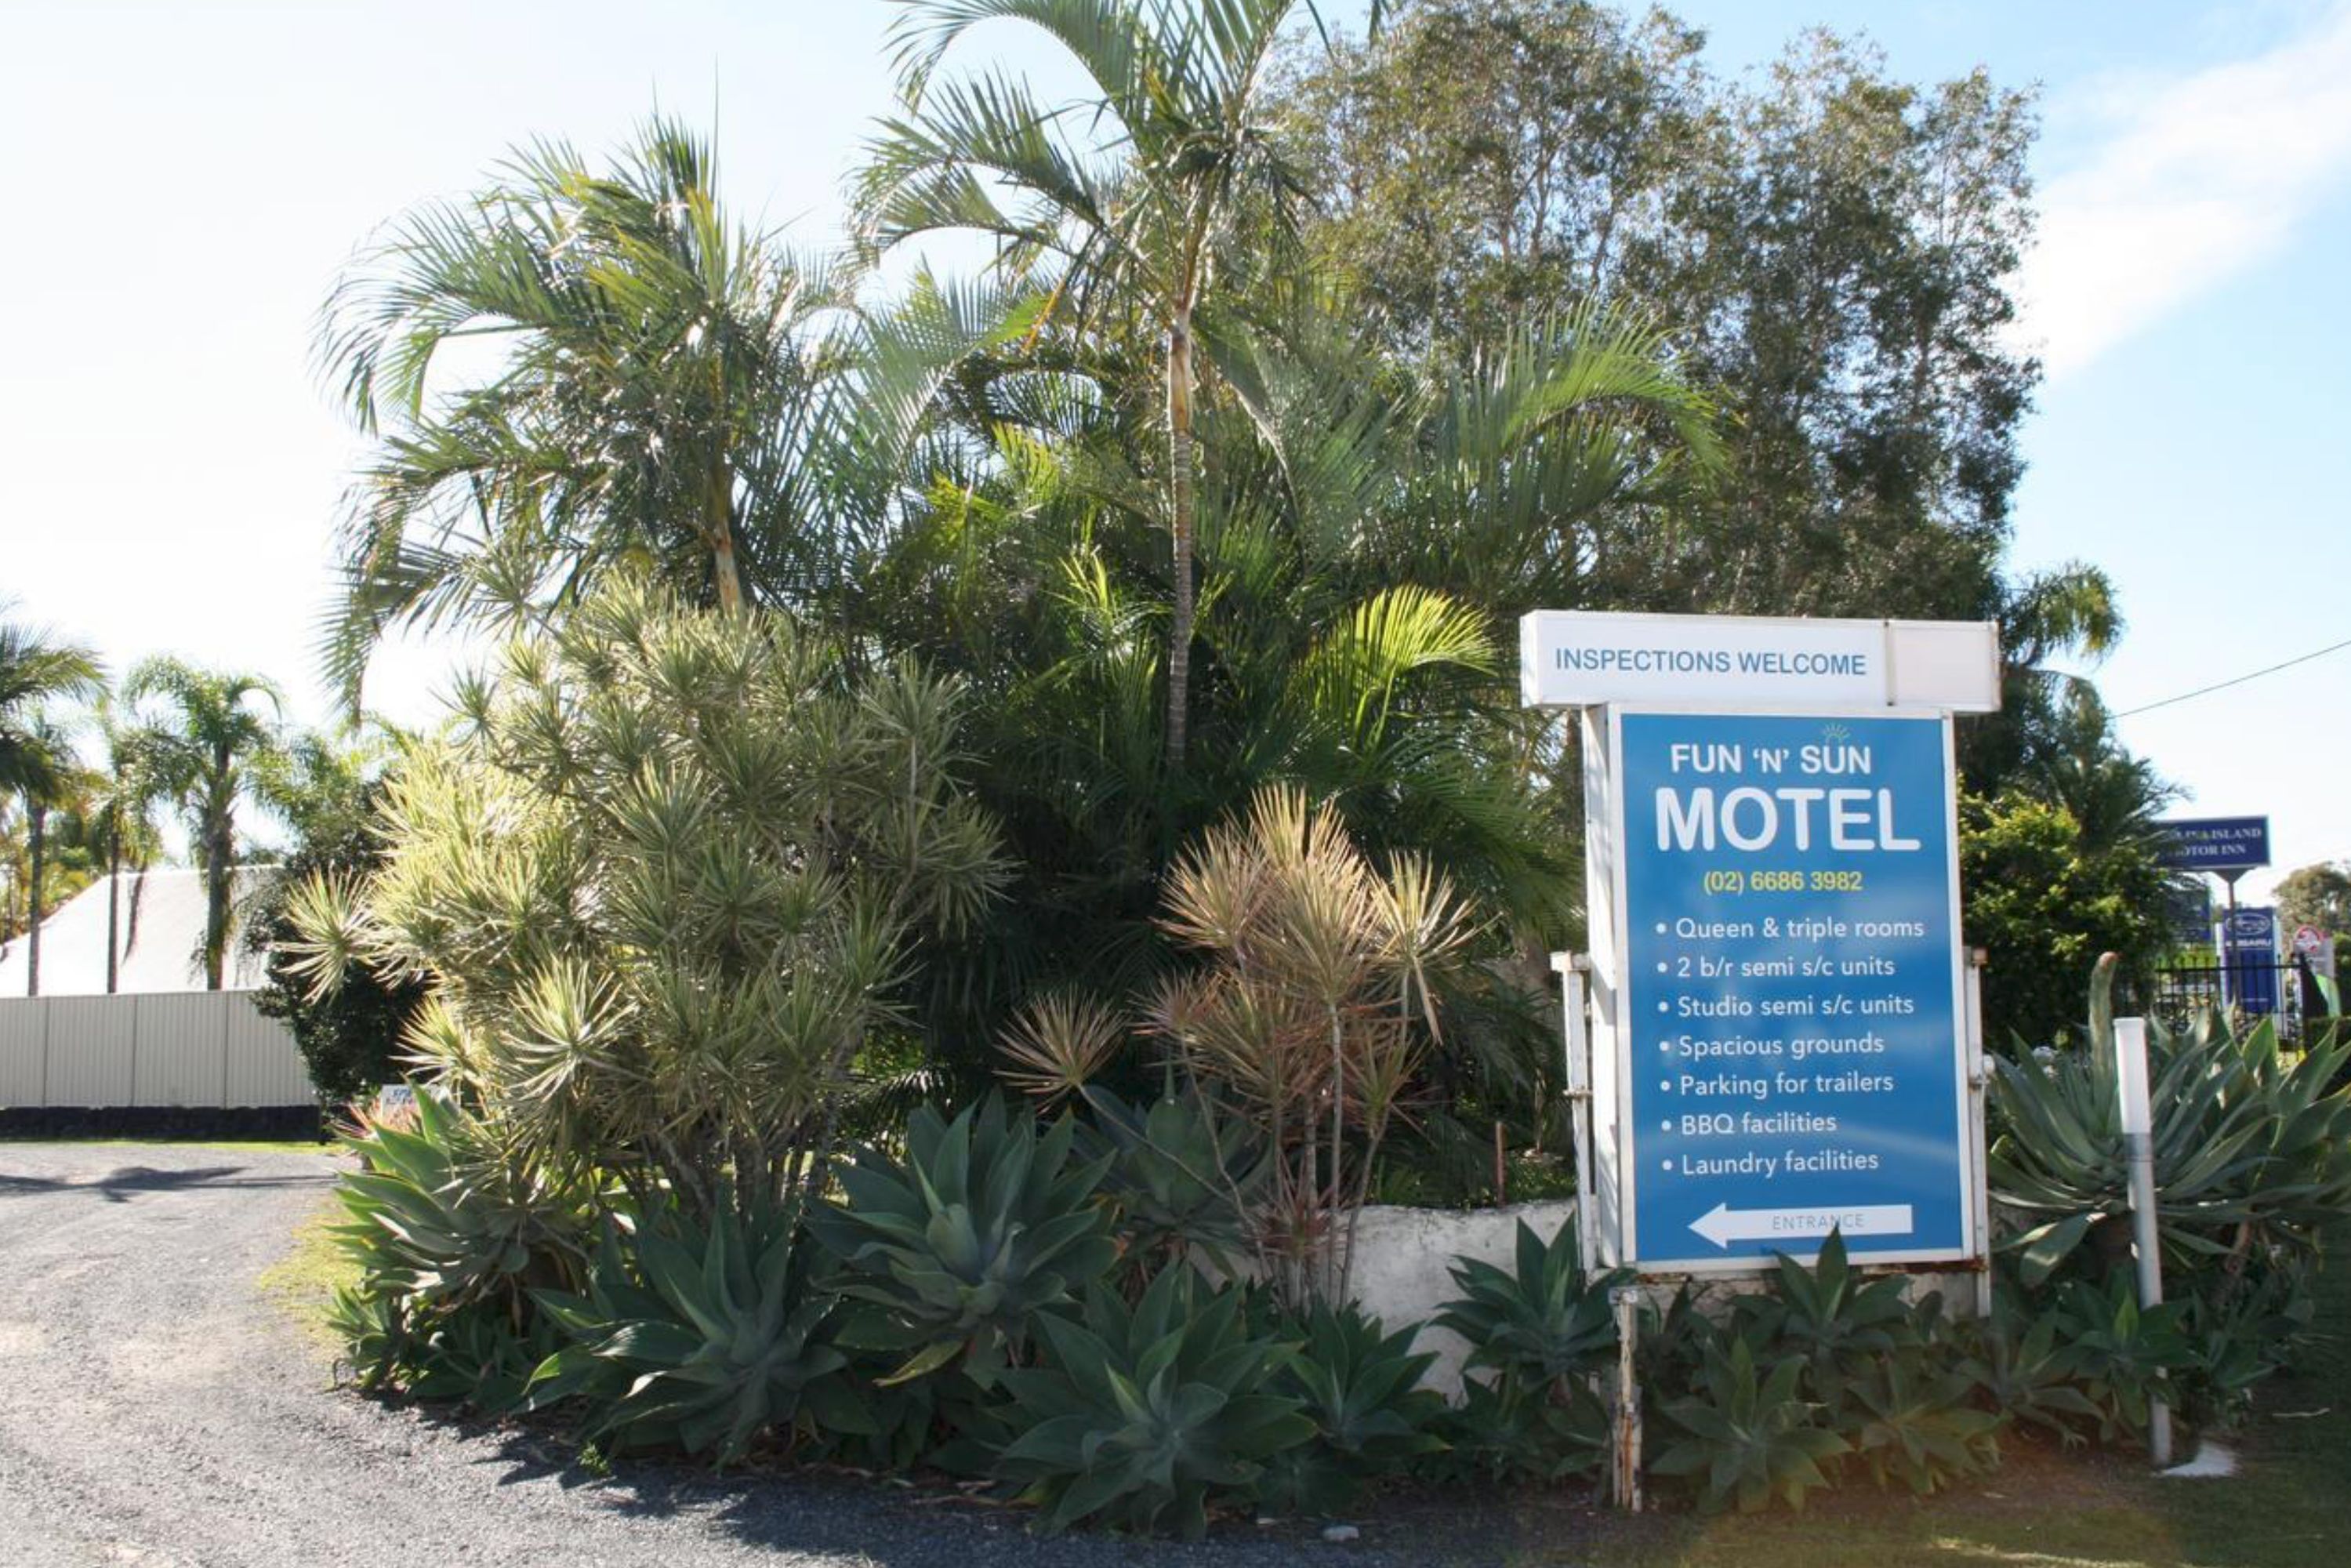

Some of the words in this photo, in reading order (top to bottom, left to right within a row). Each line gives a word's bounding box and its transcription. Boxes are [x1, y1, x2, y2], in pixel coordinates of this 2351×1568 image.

[1556, 648, 1731, 673] INSPECTIONS
[1737, 652, 1867, 676] WELCOME
[1671, 743, 1742, 774] FUN
[1801, 745, 1871, 775] SUN
[1655, 787, 1921, 851] MOTEL
[2211, 828, 2262, 840] ISLAND
[2221, 844, 2247, 855] INN
[1703, 870, 1745, 896] (02)
[1751, 870, 1805, 892] 6686
[1809, 870, 1863, 892] 3982
[1675, 917, 1754, 939] Queen
[1762, 916, 1780, 938] &
[1787, 916, 1848, 943] triple
[1854, 920, 1925, 938] rooms
[1677, 956, 1692, 978] 2
[1700, 955, 1734, 978] b/r
[1740, 956, 1794, 978] semi
[1801, 954, 1834, 978] s/c
[1841, 956, 1896, 977] units
[1677, 996, 1753, 1018] Studio
[1759, 995, 1814, 1017] semi
[1821, 994, 1854, 1017] s/c
[1859, 994, 1915, 1015] units
[1678, 1035, 1783, 1062] Spacious
[1790, 1031, 1885, 1061] grounds
[1680, 1073, 1768, 1100] Parking
[1775, 1072, 1809, 1094] for
[1815, 1071, 1895, 1093] trailers
[1681, 1113, 1735, 1136] BBQ
[1740, 1111, 1838, 1135] facilities
[1682, 1151, 1777, 1178] Laundry
[1783, 1149, 1880, 1174] facilities
[1772, 1214, 1865, 1230] ENTRANCE
